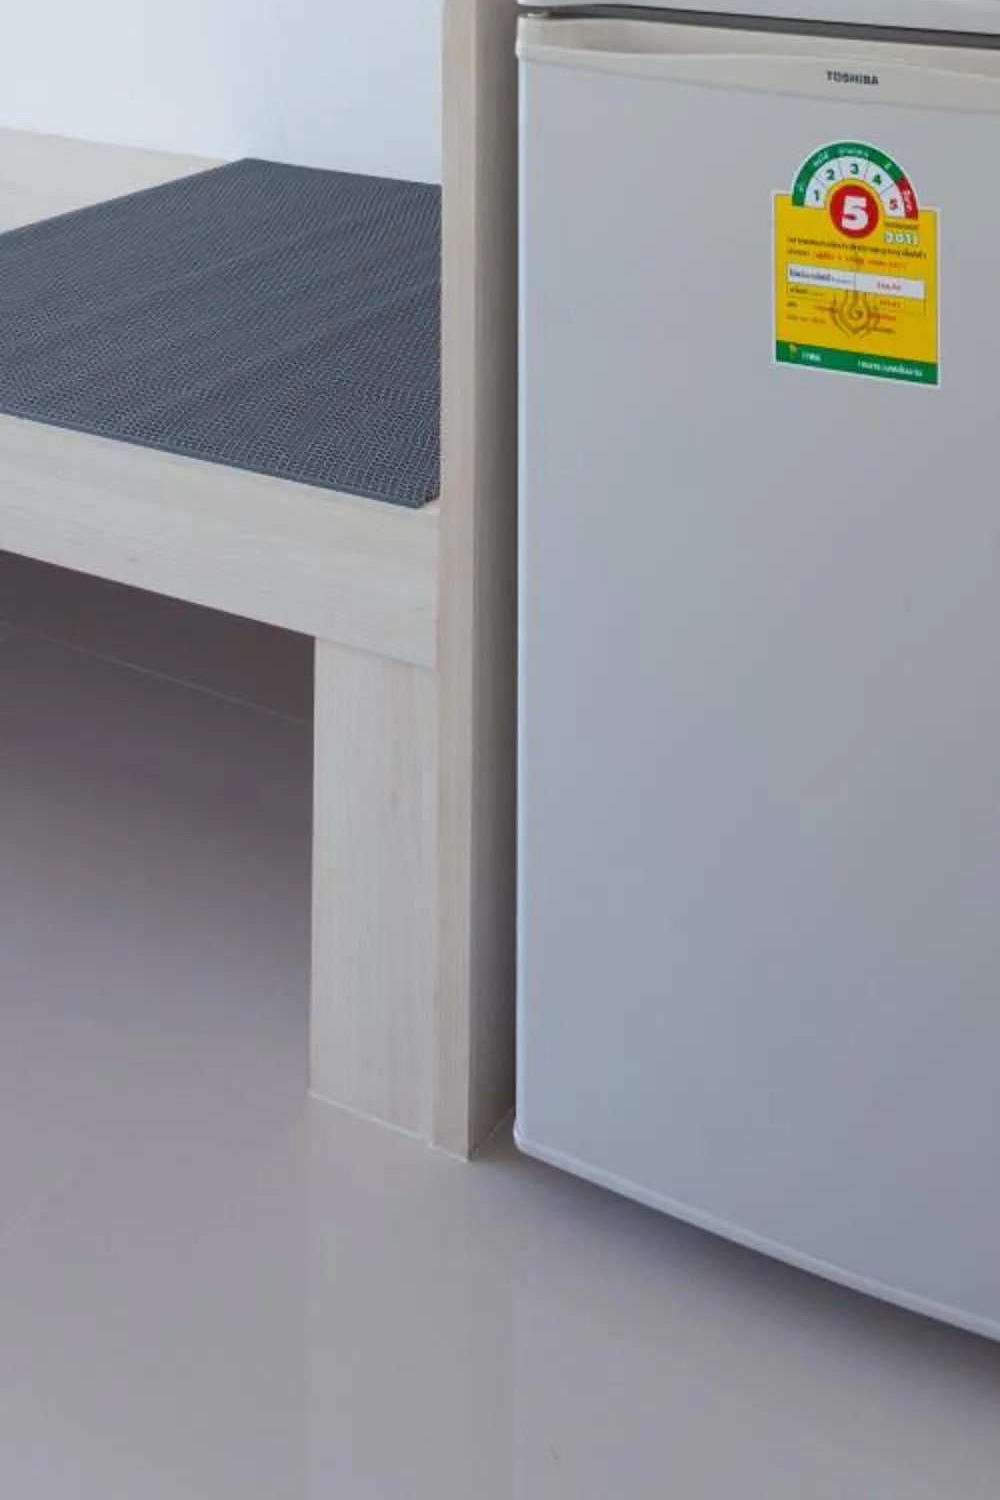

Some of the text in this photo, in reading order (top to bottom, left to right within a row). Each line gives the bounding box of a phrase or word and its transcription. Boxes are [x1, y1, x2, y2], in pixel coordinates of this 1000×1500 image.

[826, 69, 880, 85] TOSHIBA
[813, 189, 820, 201] 1
[825, 168, 836, 181] 2
[849, 163, 859, 175] 3
[871, 173, 882, 185] 4
[889, 198, 899, 211] 5
[841, 194, 869, 232] 5
